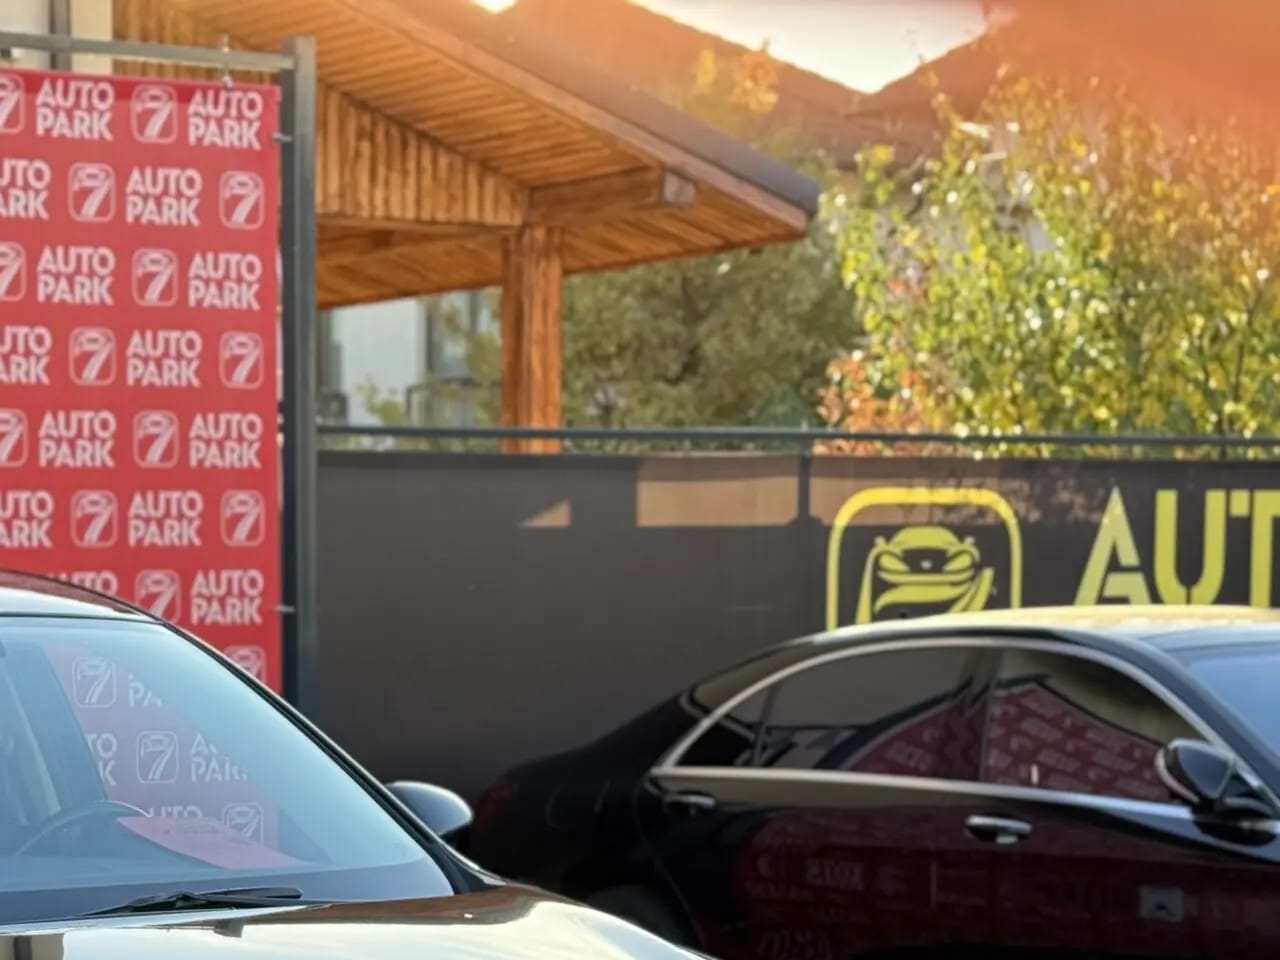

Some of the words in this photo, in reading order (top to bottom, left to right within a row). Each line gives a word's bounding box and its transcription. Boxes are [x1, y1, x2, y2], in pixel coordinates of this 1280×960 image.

[36, 79, 114, 109] AUTO
[188, 91, 263, 120] AUTO
[36, 110, 112, 140] PARK
[189, 119, 261, 150] PARK
[126, 167, 202, 198] AUTO
[126, 197, 200, 226] PARK
[37, 246, 115, 277] AUTO
[188, 252, 262, 283] AUTO
[37, 276, 113, 305] PARK
[188, 282, 260, 310] PARK
[126, 330, 202, 359] AUTO
[127, 360, 200, 387] PARK
[39, 410, 116, 439] AUTO
[189, 413, 262, 441] AUTO
[39, 440, 114, 467] PARK
[189, 441, 261, 468] PARK
[128, 490, 203, 519] AUTO
[128, 519, 201, 547] PARK
[191, 569, 264, 598] AUTO
[191, 598, 262, 625] PARK
